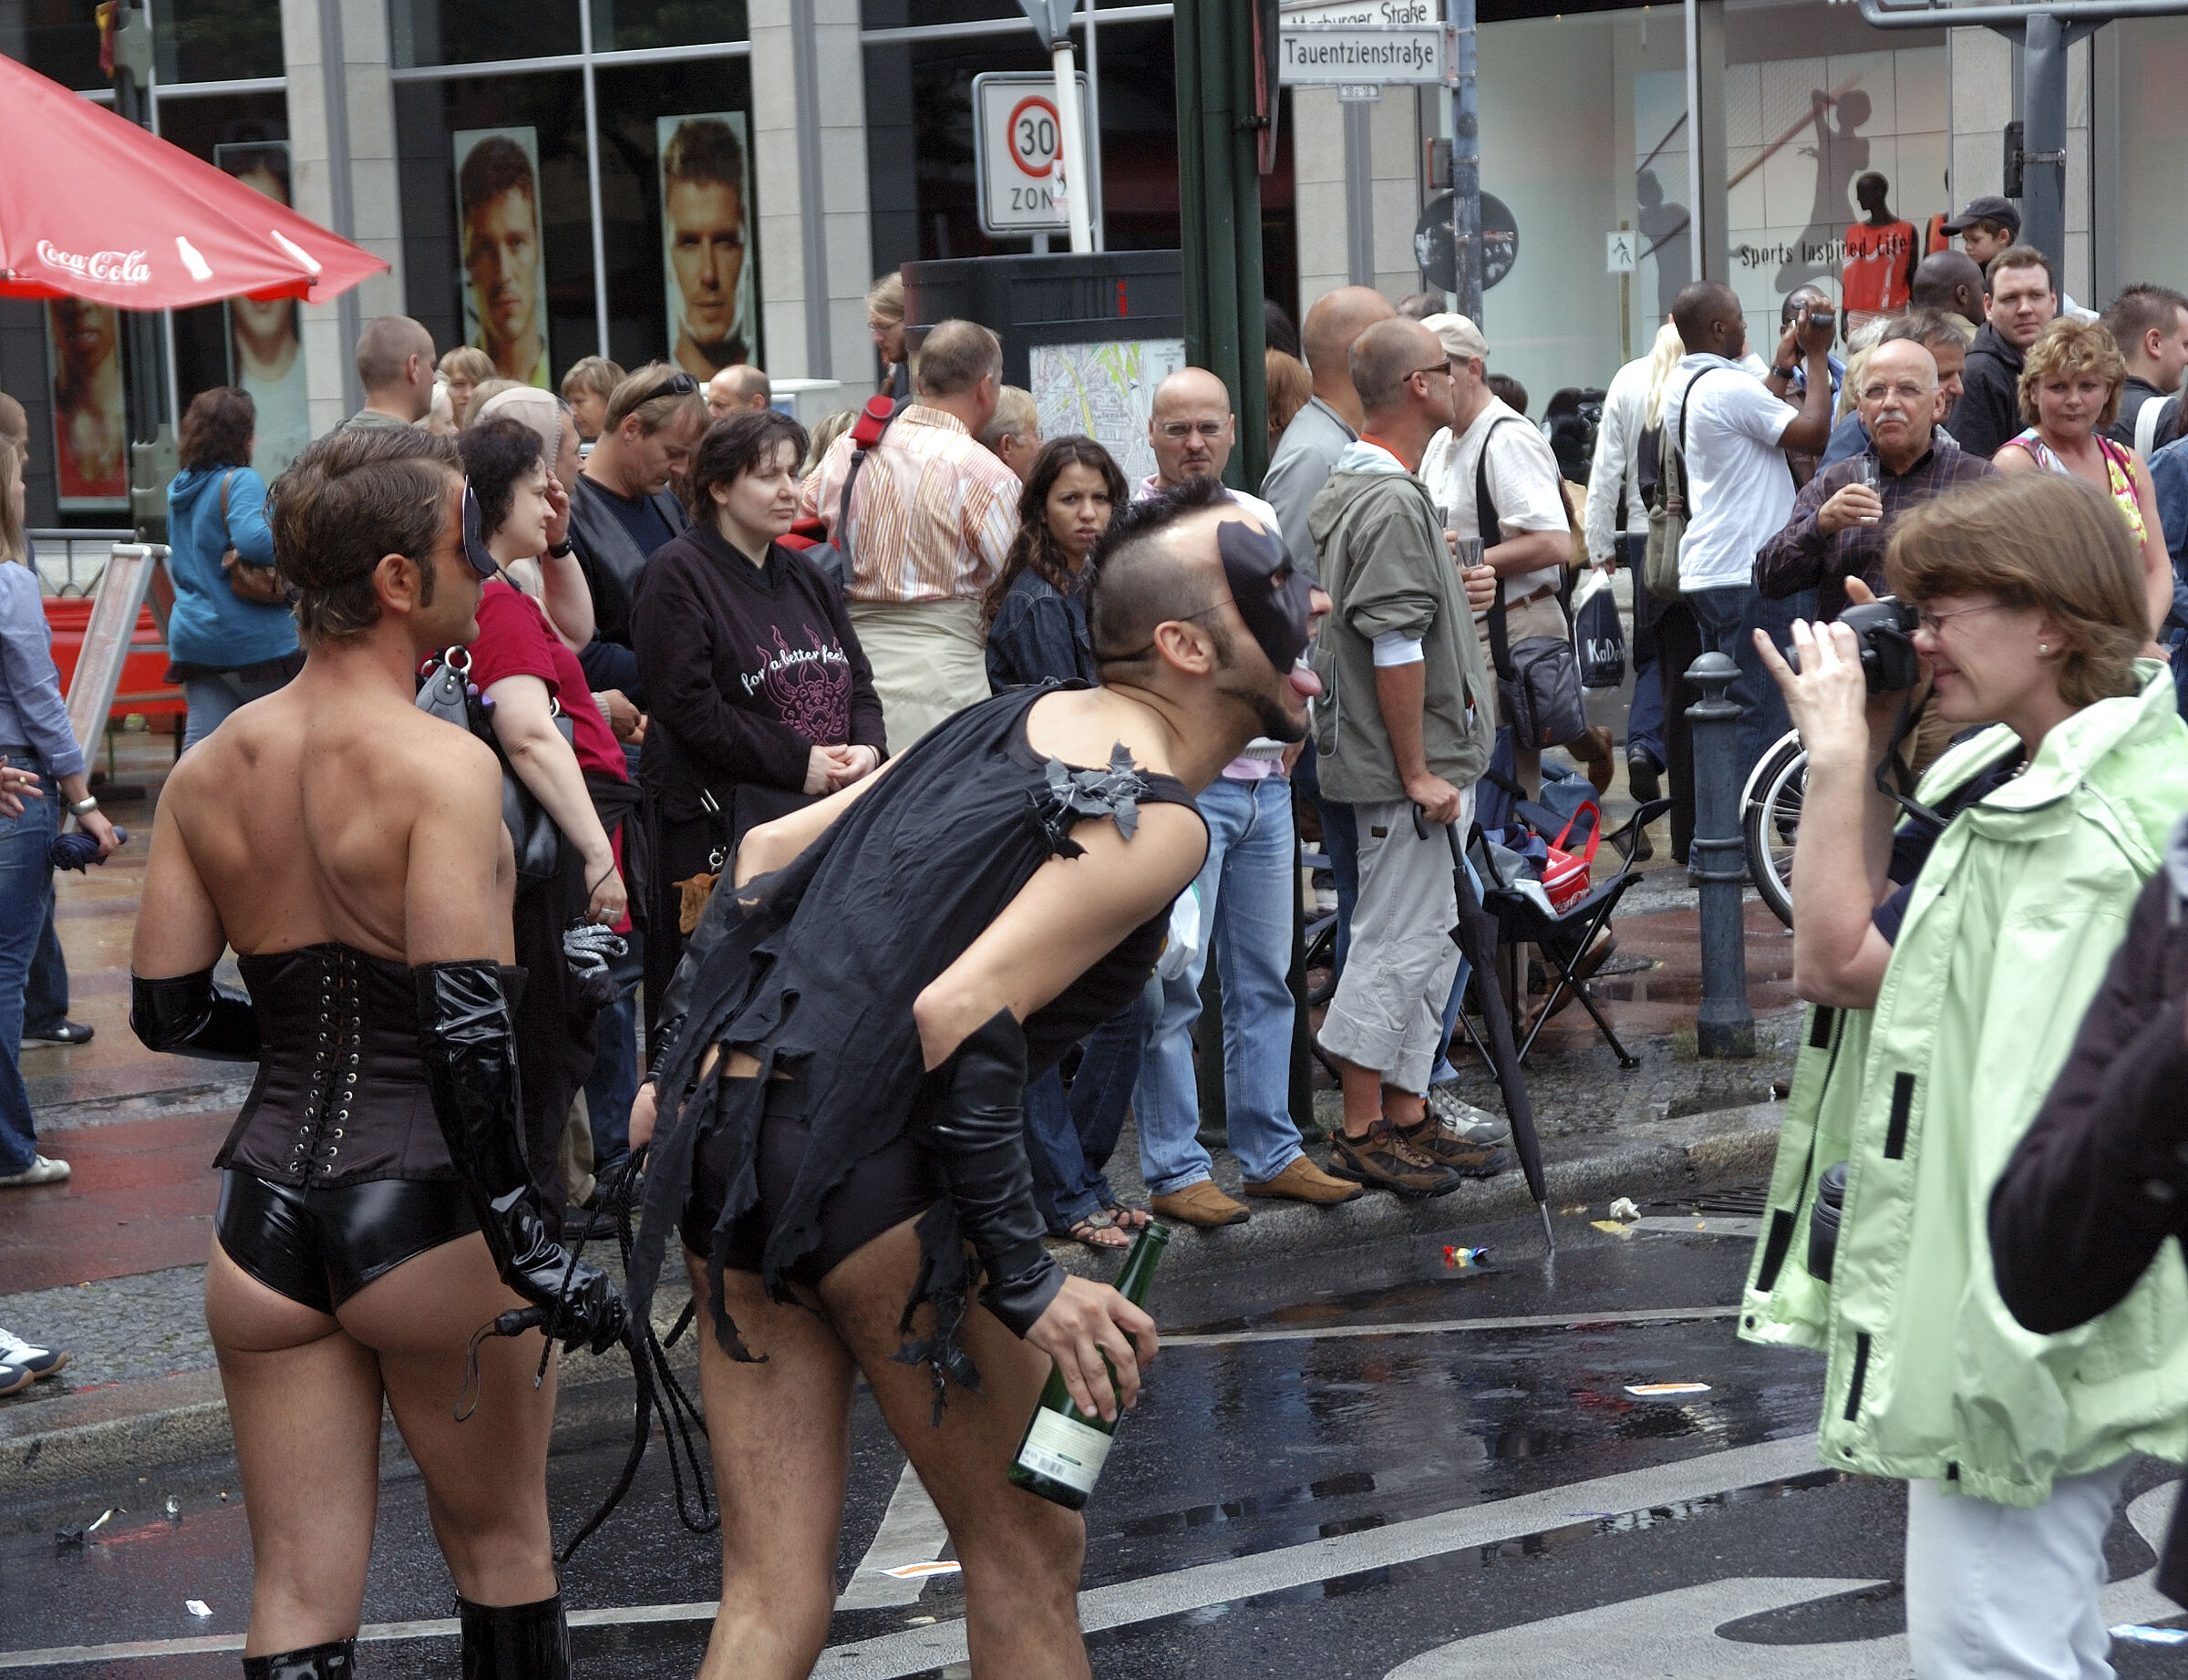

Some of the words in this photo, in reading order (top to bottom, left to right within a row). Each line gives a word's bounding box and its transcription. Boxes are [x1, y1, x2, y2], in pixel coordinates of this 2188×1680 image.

[1291, 12, 1372, 24] burger
[1380, 0, 1428, 24] Straße
[1284, 38, 1434, 70] Tauentzienstraße
[1019, 118, 1054, 155] 30
[1011, 187, 1054, 211] ZON
[36, 239, 151, 283] Coca-Cola
[1741, 242, 1793, 269] Sports
[1801, 236, 1867, 264] Inspired
[1876, 232, 1907, 256] Life
[740, 668, 766, 696] for
[770, 660, 781, 670] a
[780, 648, 820, 665] better
